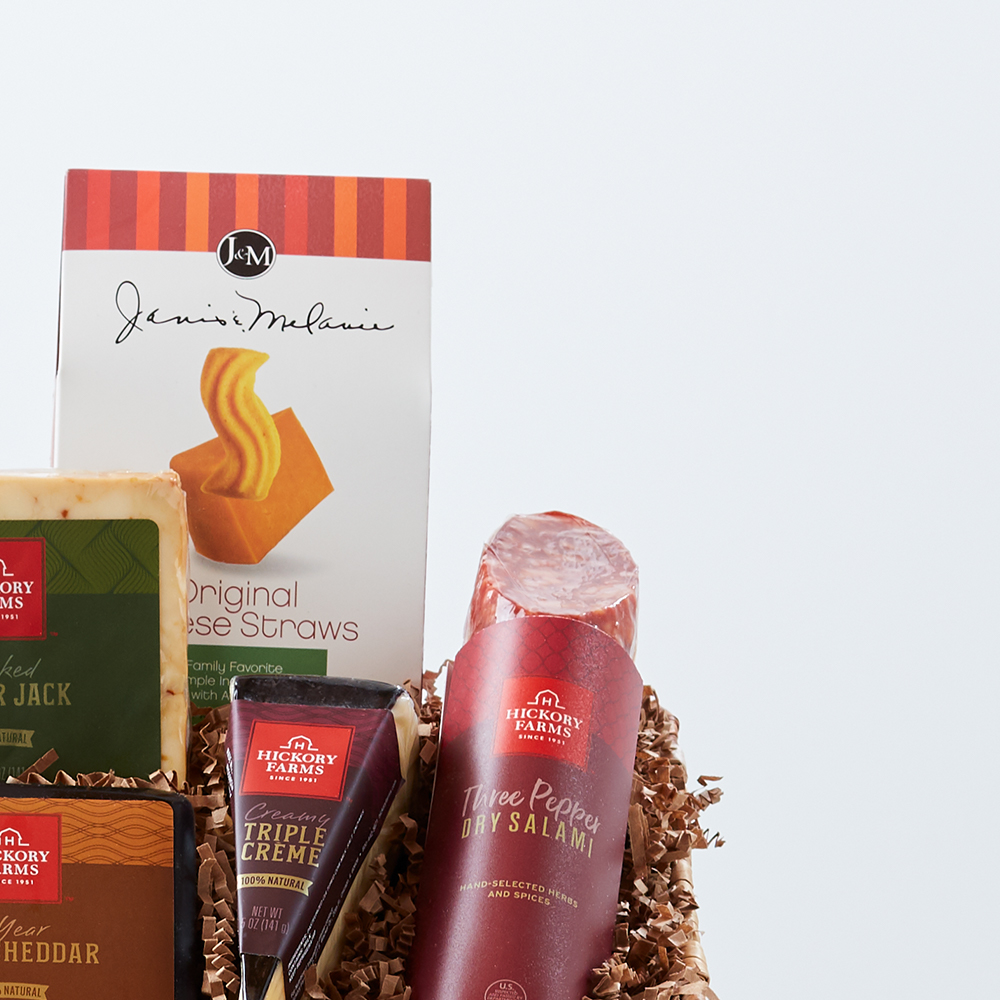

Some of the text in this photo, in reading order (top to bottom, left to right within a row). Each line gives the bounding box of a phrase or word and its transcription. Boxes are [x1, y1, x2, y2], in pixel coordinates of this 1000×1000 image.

[224, 237, 272, 267] J&M
[235, 290, 395, 335] Melanie
[240, 611, 359, 642] Straws
[229, 661, 283, 674] Favorite
[188, 674, 216, 688] mple
[13, 682, 72, 706] JACK
[191, 690, 218, 700] with
[505, 707, 584, 731] HICKORY
[514, 720, 572, 739] FARMS
[518, 733, 566, 746] SINCE 1951
[256, 750, 338, 765] HICKORY
[266, 761, 324, 776] FARMS
[461, 778, 601, 834] Three Pepper
[244, 802, 331, 828] Creamy
[244, 822, 327, 847] TRIPLE
[461, 811, 594, 858] DRY SALAMI
[241, 876, 305, 891] 100% NATURAL
[459, 880, 579, 909] HAND-SELECTED HERBS
[487, 890, 551, 906] AND SPICES
[251, 905, 283, 919] NET WT
[247, 917, 260, 930] OZ
[260, 918, 279, 932] (141
[3, 985, 42, 999] NATURAL
